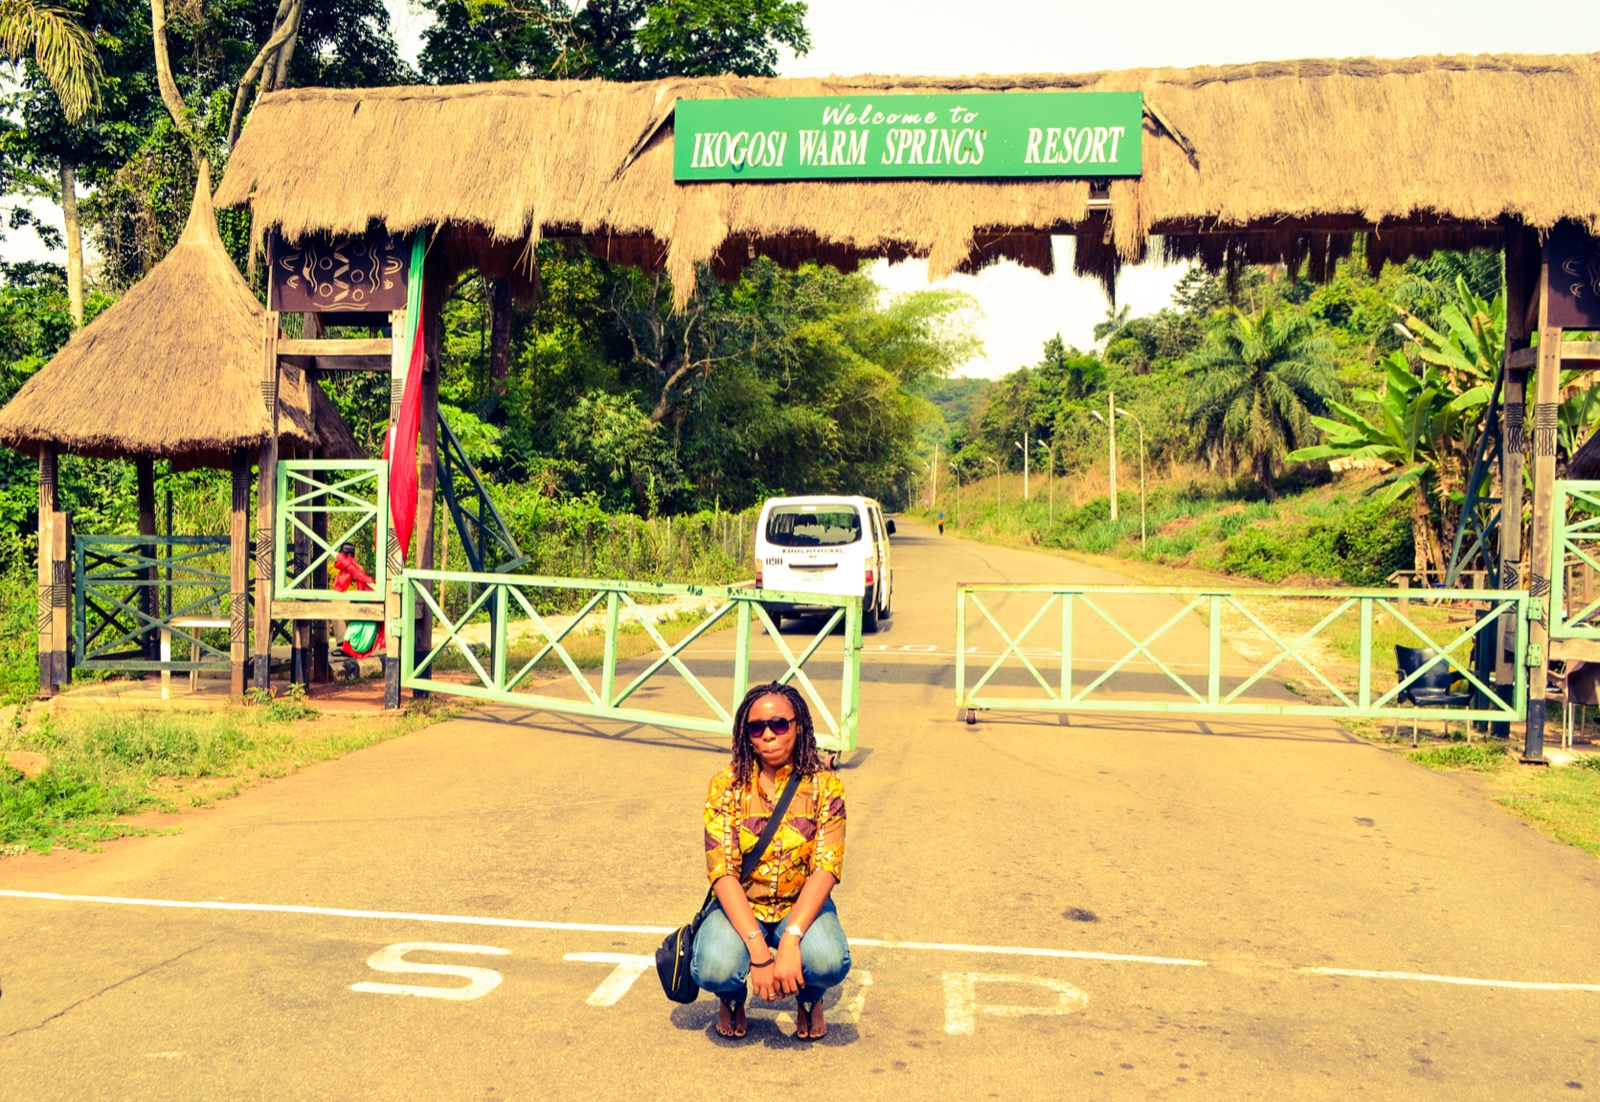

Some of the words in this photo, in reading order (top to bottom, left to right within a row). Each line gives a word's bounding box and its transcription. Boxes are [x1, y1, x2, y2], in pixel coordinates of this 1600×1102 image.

[822, 102, 937, 125] Welcome
[949, 106, 978, 124] to
[690, 131, 789, 168] IKOGOSI
[799, 129, 869, 166] WARM
[881, 128, 987, 165] SPRINGS
[1024, 126, 1125, 164] RESORT
